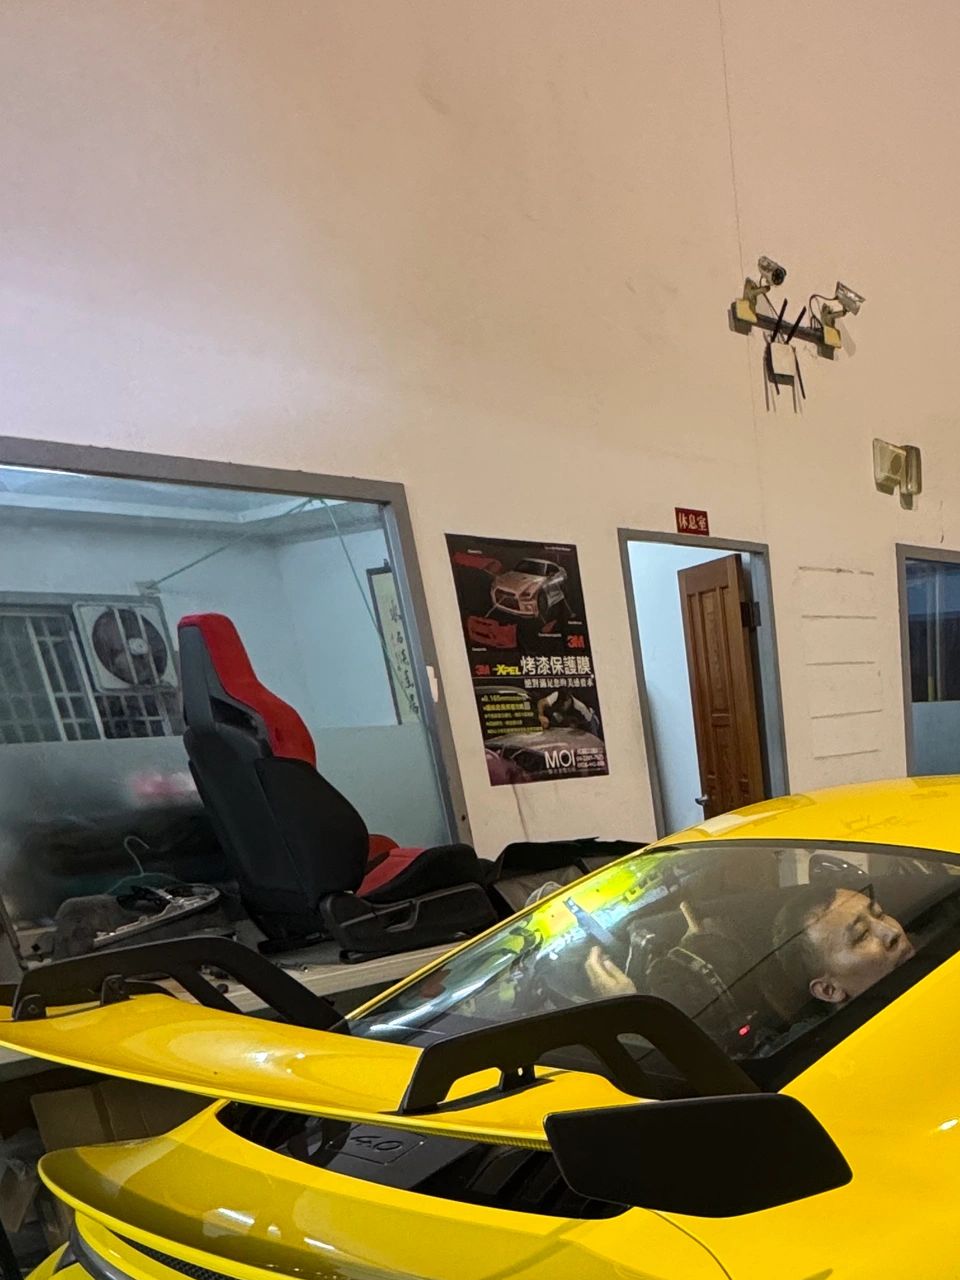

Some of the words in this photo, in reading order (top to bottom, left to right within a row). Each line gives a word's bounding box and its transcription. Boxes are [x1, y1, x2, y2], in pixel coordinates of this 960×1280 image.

[678, 511, 707, 531] 休息室
[567, 635, 585, 648] 3M
[496, 664, 522, 676] XPEL
[520, 655, 592, 676] 烤漆保護膜
[544, 749, 576, 769] MOI
